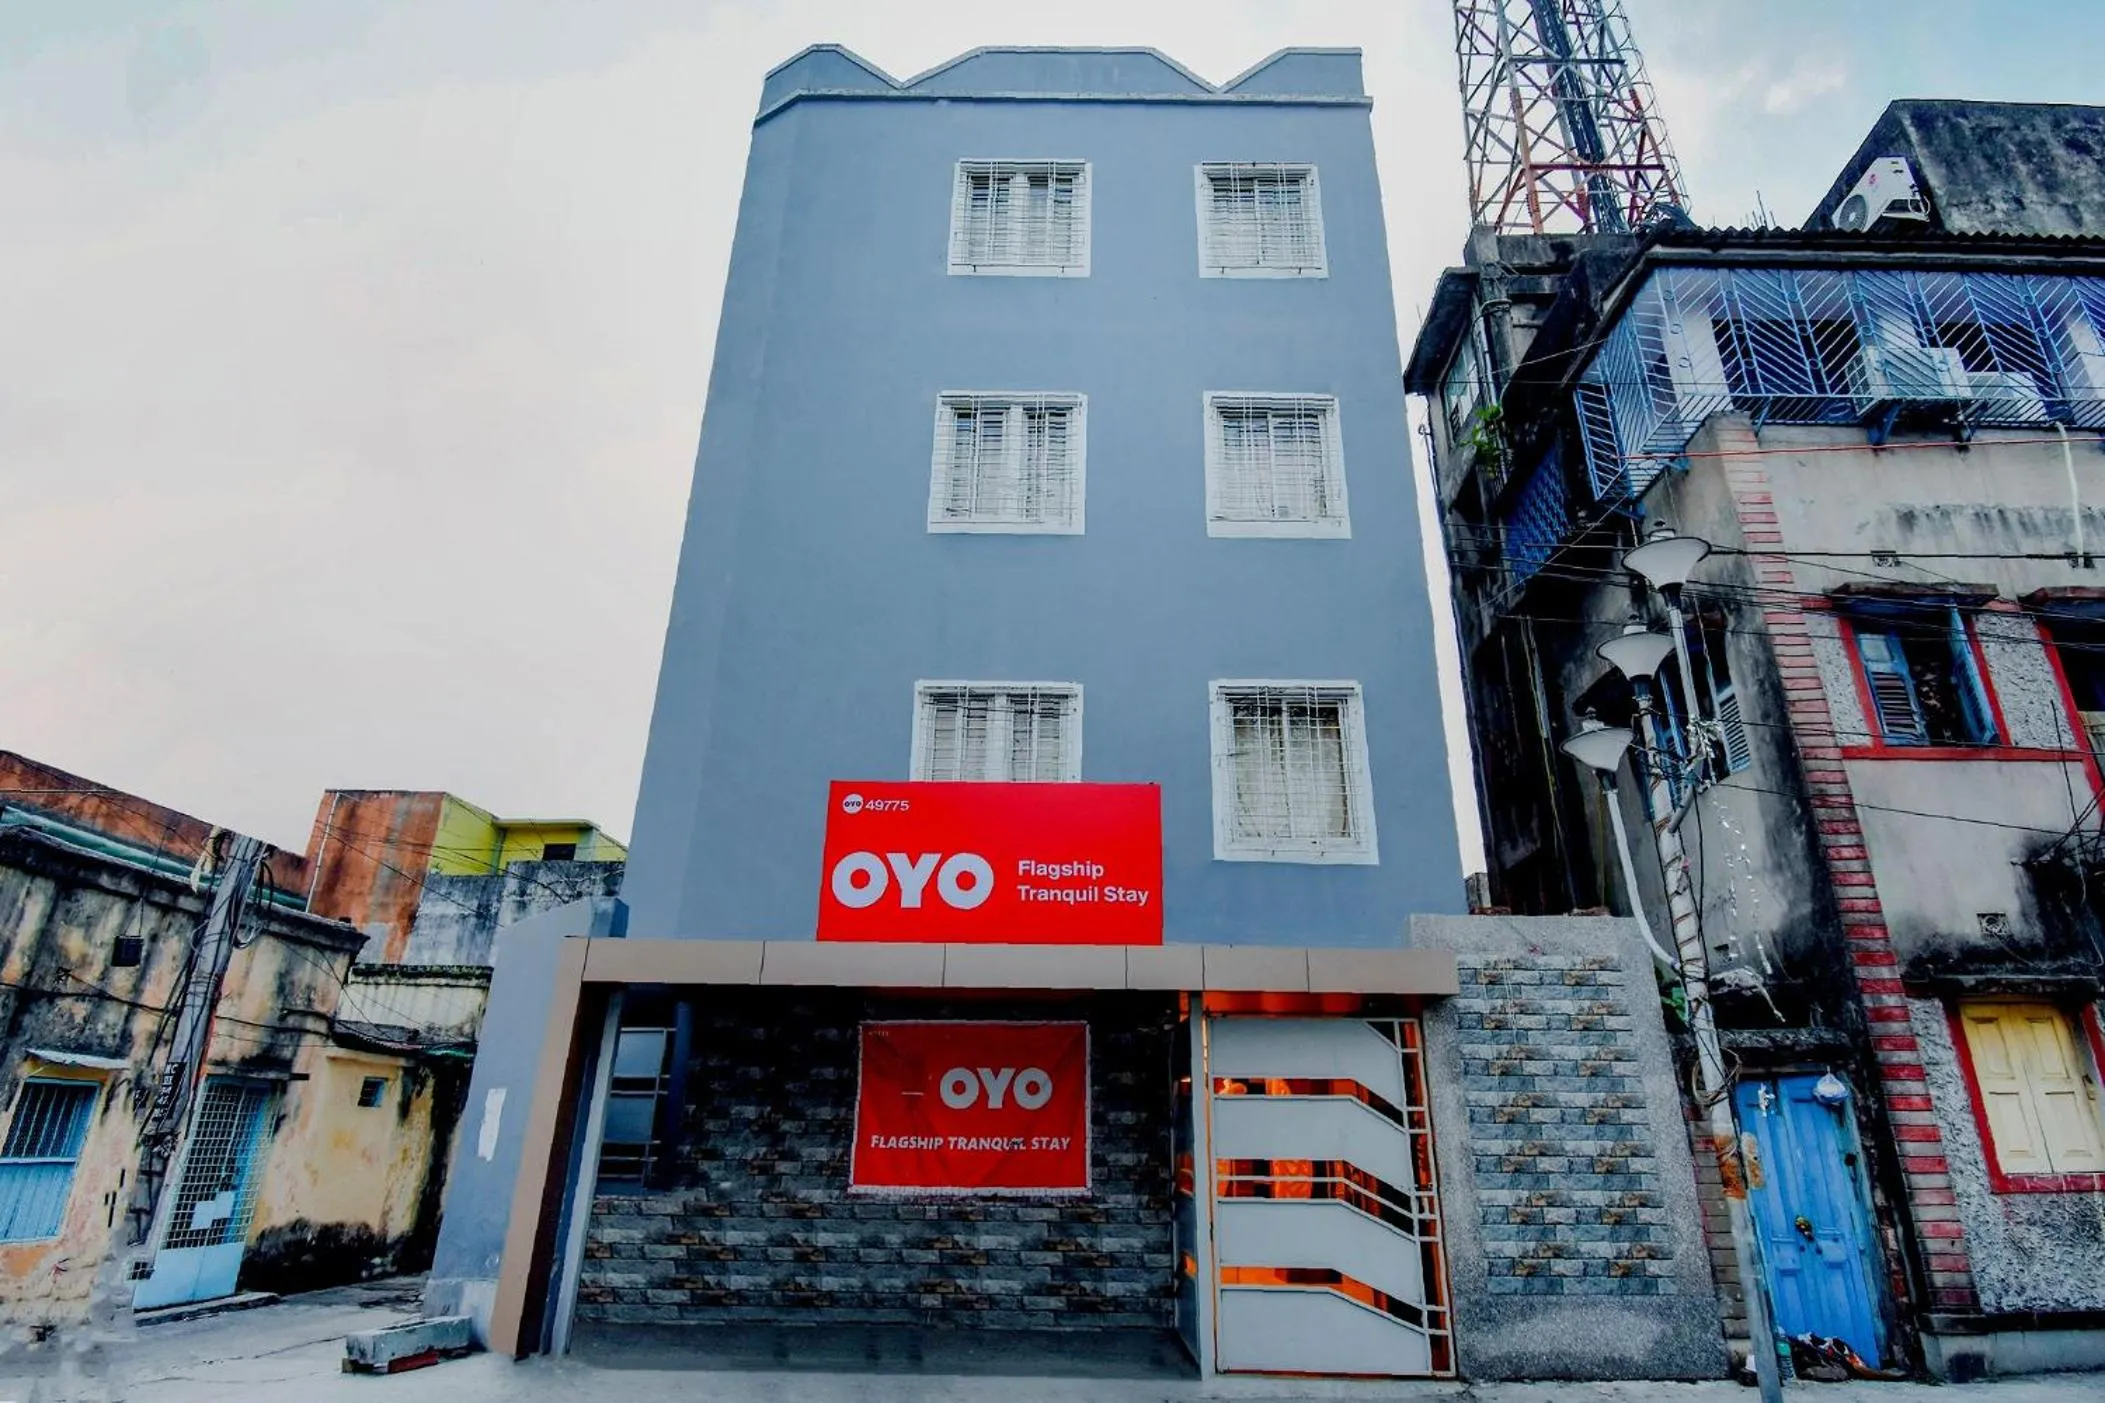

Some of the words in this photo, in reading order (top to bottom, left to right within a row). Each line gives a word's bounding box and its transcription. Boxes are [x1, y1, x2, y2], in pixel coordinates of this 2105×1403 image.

[865, 799, 910, 812] 49775
[831, 851, 995, 910] OYO
[1017, 859, 1105, 880] Flagship
[1016, 884, 1099, 905] Tranquil
[1103, 885, 1149, 907] Stay
[939, 1067, 1053, 1110] OYO
[870, 1134, 944, 1150] FLAGSHIP
[1031, 1137, 1071, 1151] STAY
